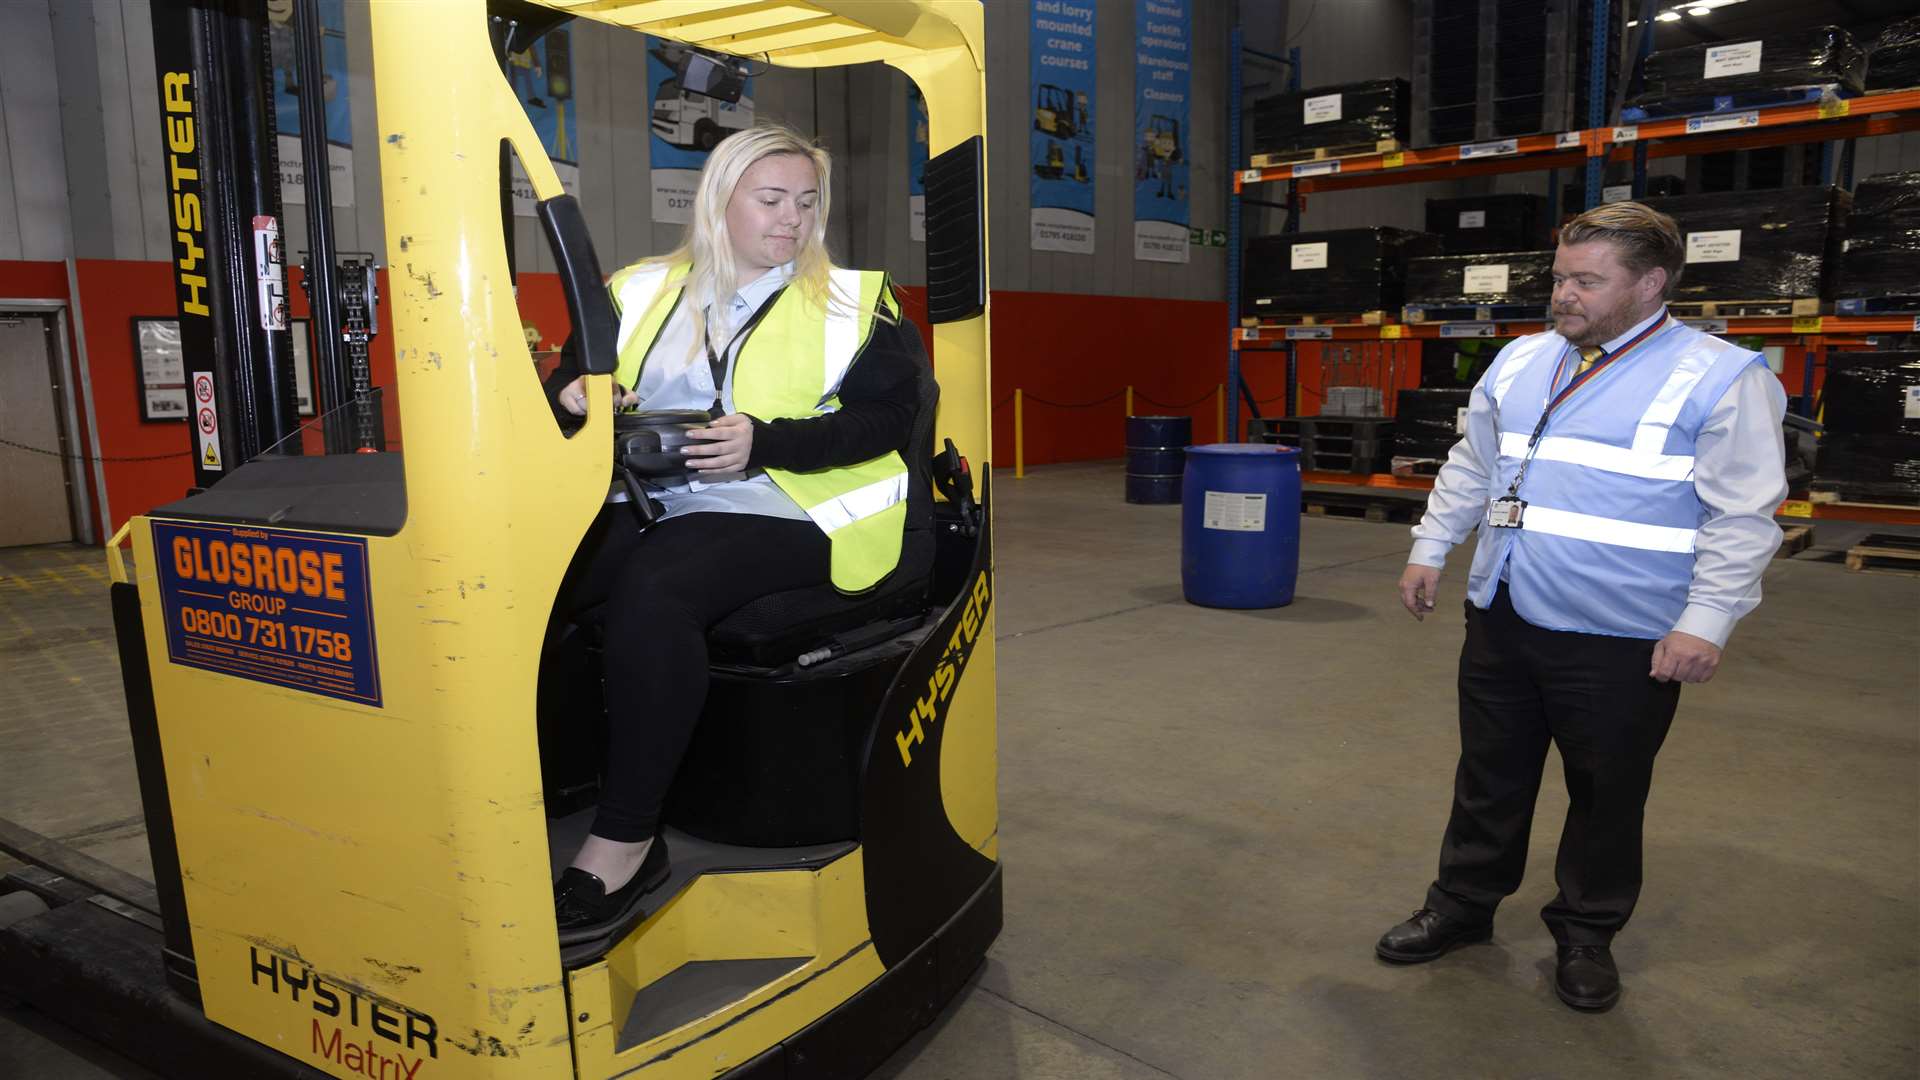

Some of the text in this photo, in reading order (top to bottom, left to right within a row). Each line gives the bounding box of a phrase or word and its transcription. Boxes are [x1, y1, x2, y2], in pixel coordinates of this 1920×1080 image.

[1036, 1, 1092, 21] and lorry
[1146, 2, 1182, 18] Wanted
[1036, 19, 1092, 37] mounted
[1147, 21, 1181, 38] Forklift
[1047, 38, 1082, 52] crane
[1041, 55, 1088, 70] courses
[1143, 88, 1184, 103] Cleaners
[163, 71, 209, 317] HYSTER
[232, 528, 268, 541] Supplied by
[172, 536, 346, 600] GLOSROSE
[229, 591, 287, 615] GROUP
[181, 606, 352, 662] 0800 731 1758
[895, 570, 990, 768] HYSTER
[250, 946, 438, 1059] HYSTER
